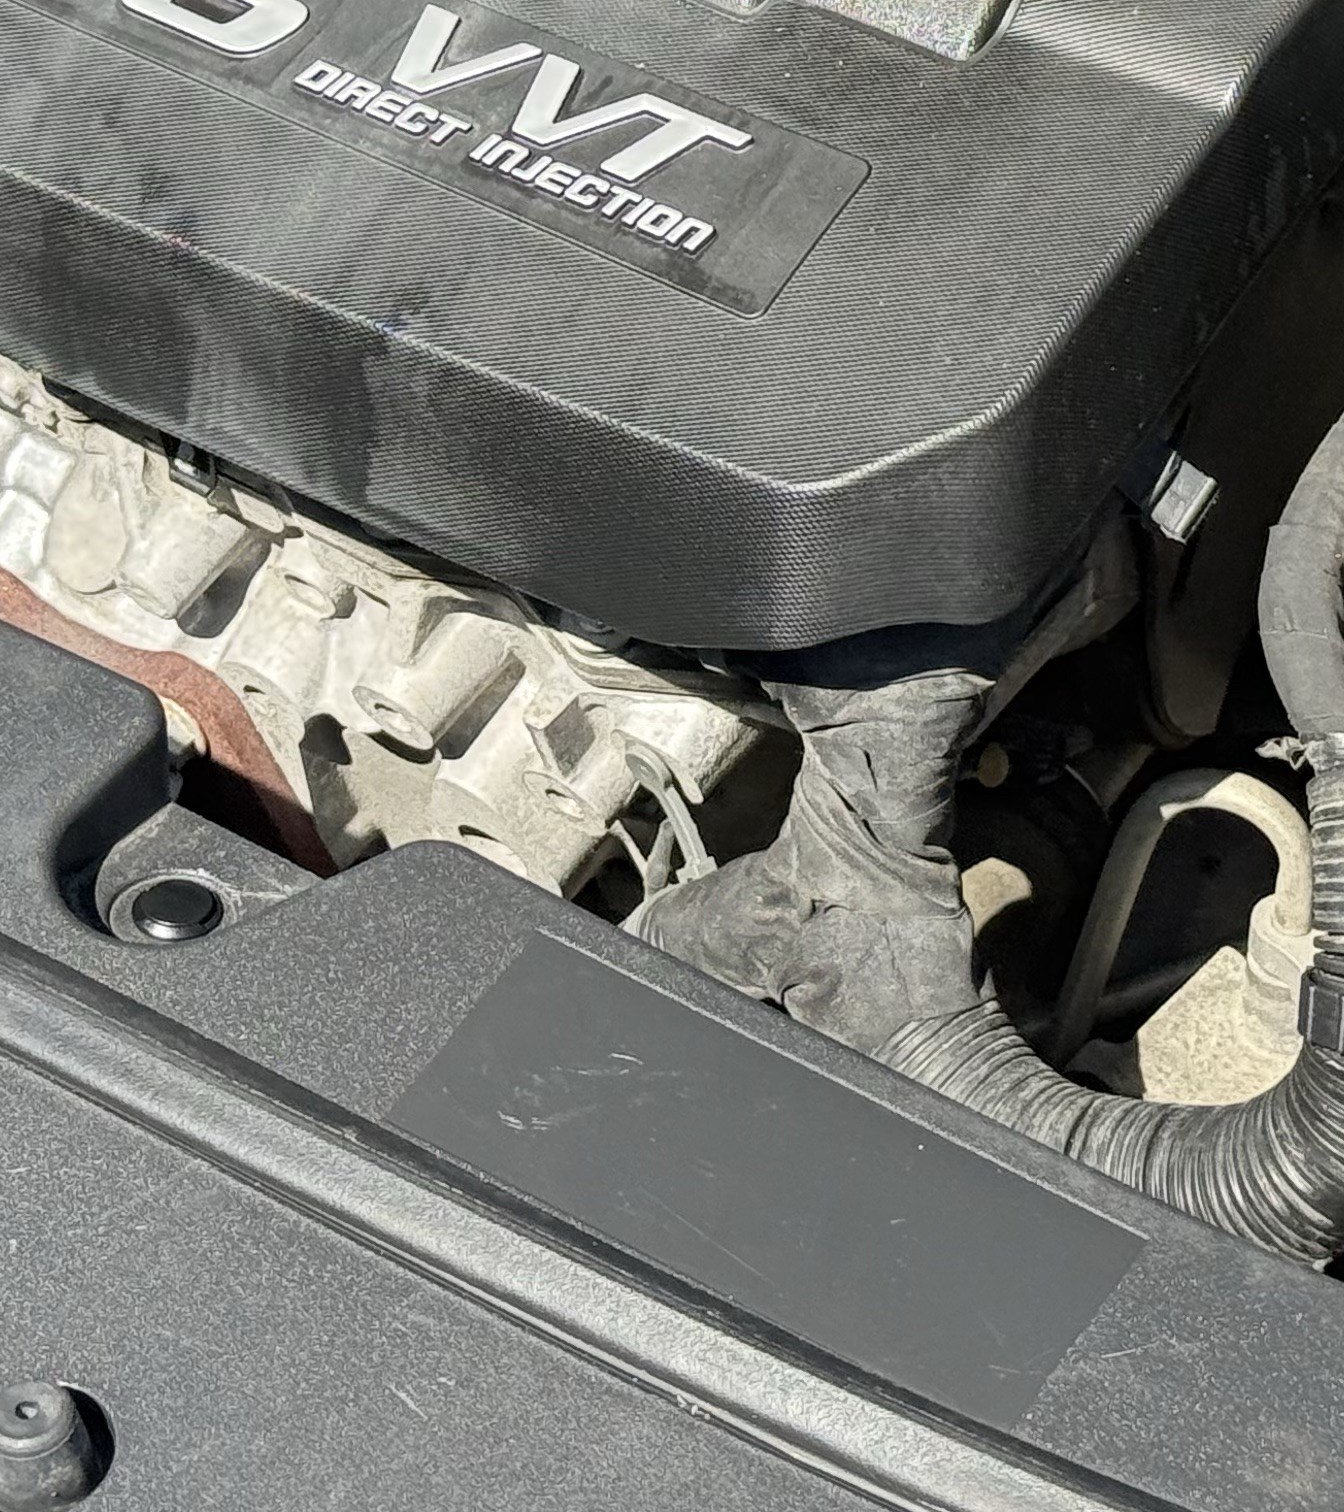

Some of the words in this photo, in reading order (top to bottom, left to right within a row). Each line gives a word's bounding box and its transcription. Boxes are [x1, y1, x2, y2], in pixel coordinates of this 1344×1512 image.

[294, 59, 472, 145] DIRECT
[469, 133, 717, 253] INJECTION
[391, 3, 753, 182] VVT
